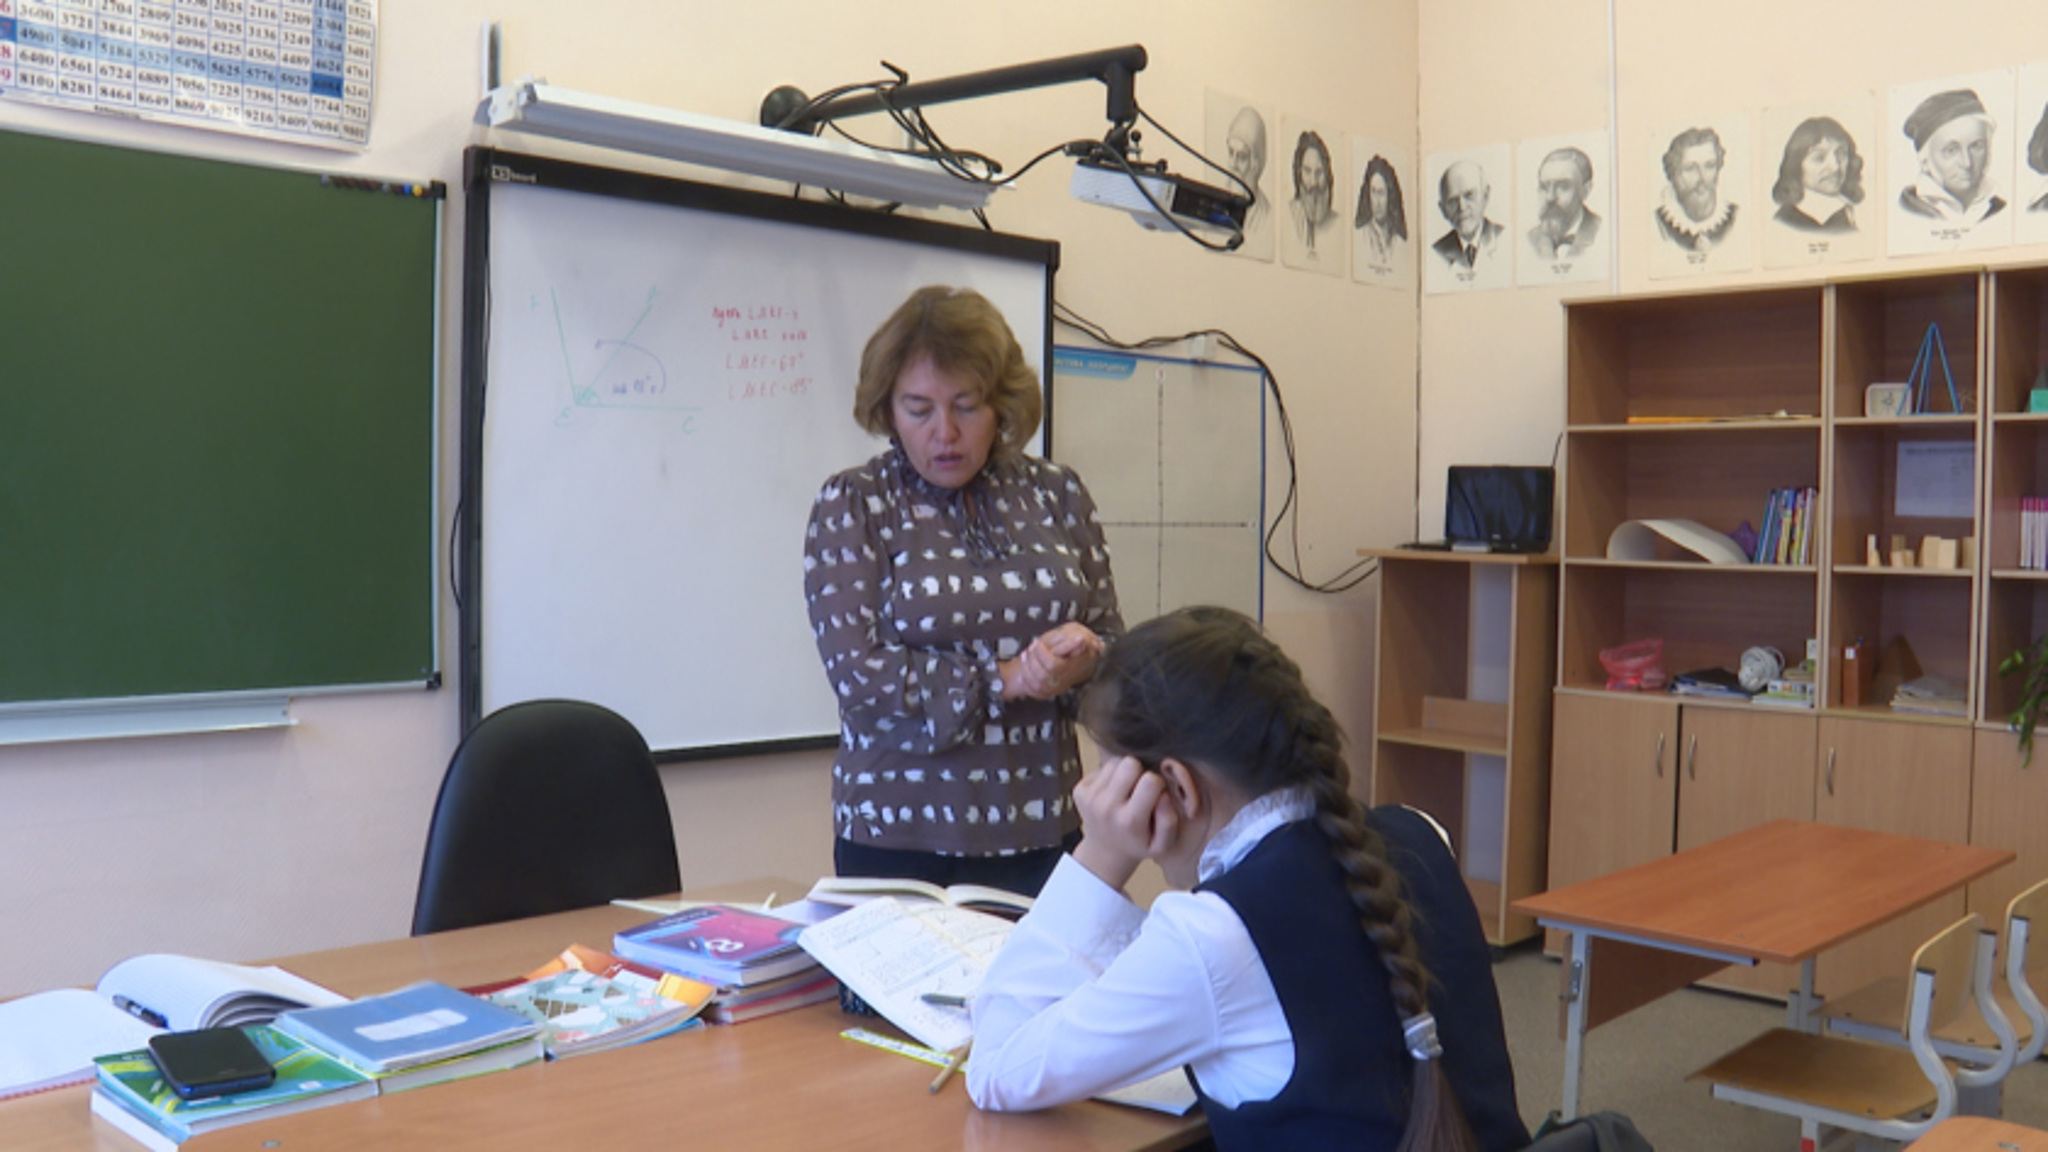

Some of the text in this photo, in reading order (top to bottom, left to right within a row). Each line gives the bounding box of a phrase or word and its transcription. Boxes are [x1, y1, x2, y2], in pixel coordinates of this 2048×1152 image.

[177, 12, 207, 29] 2916
[283, 31, 310, 46] 3249
[250, 4, 277, 20] 2116
[61, 11, 92, 30] 3721
[212, 40, 241, 57] 4225
[60, 58, 92, 75] 6561
[99, 65, 132, 80] 6724
[211, 82, 240, 97] 7225
[313, 97, 340, 113] 7744
[60, 79, 92, 96] 8281
